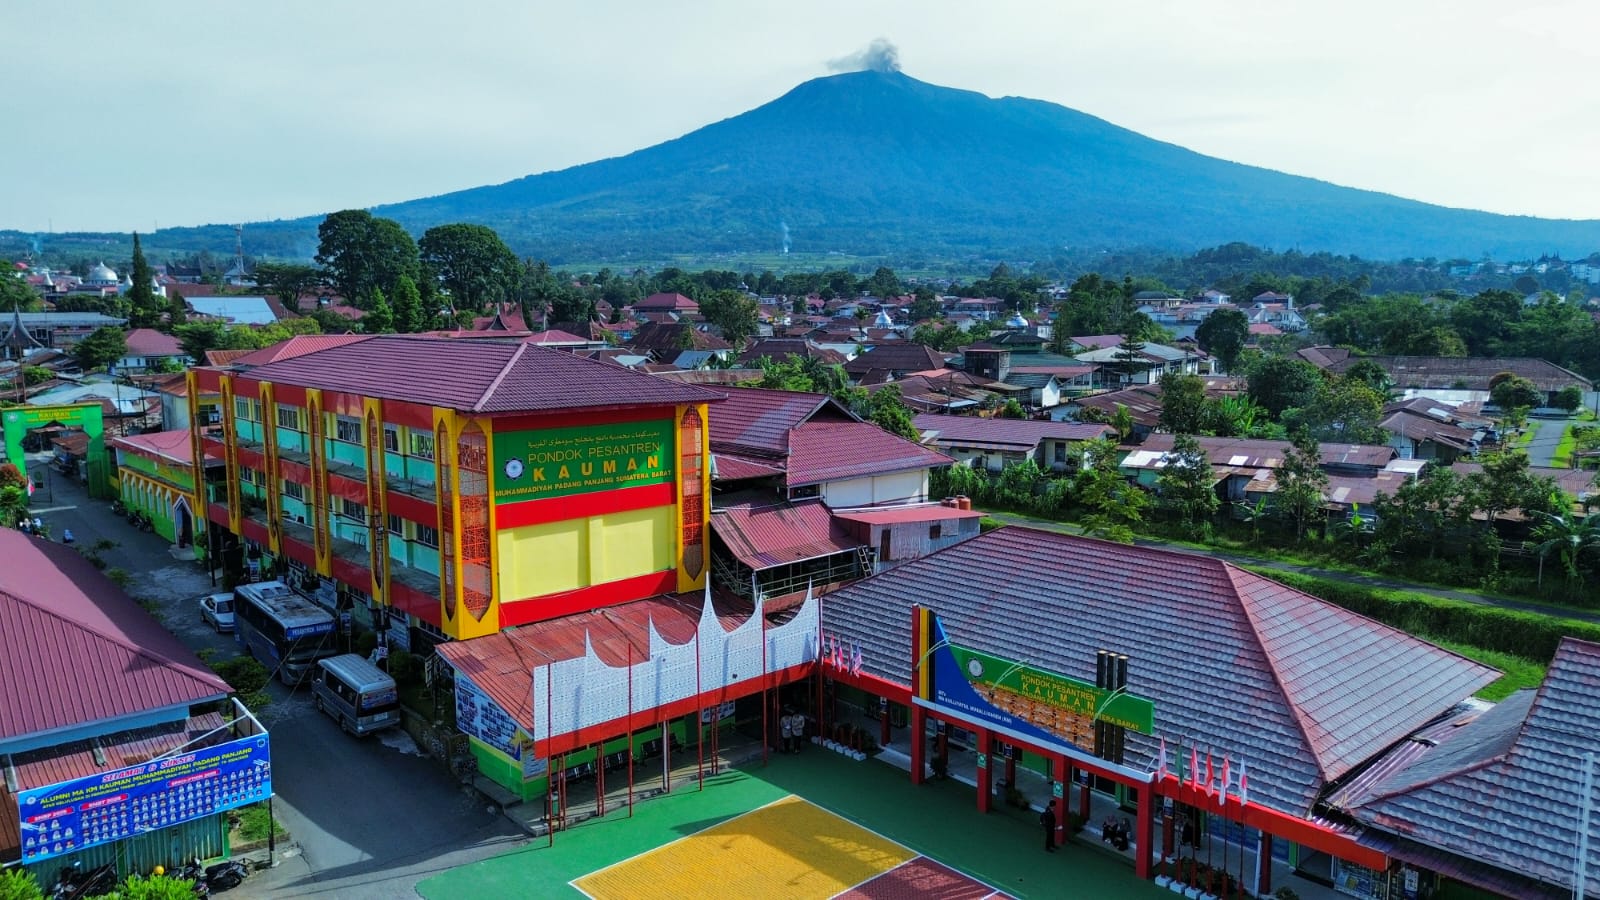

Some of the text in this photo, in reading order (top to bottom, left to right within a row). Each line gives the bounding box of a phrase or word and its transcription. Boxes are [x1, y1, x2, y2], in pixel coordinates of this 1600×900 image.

[528, 442, 660, 464] PONDOK PESANTREN
[533, 455, 658, 482] KAUMAN
[495, 470, 671, 496] MUHAMMADIYAH PADANG PANJANG SUMATERA BARAT
[1021, 674, 1050, 688] PONDOK
[1052, 684, 1096, 702] PESANTREN
[1116, 719, 1138, 730] BARAT
[40, 793, 70, 804] ALUMNI
[100, 779, 131, 790] KAUMAN
[133, 763, 191, 780] MUHAMMADIYAH
[193, 756, 220, 766] PADANG
[222, 747, 252, 759] PANJANG
[102, 766, 146, 782] SELAMAT
[160, 754, 196, 769] SUKSES
